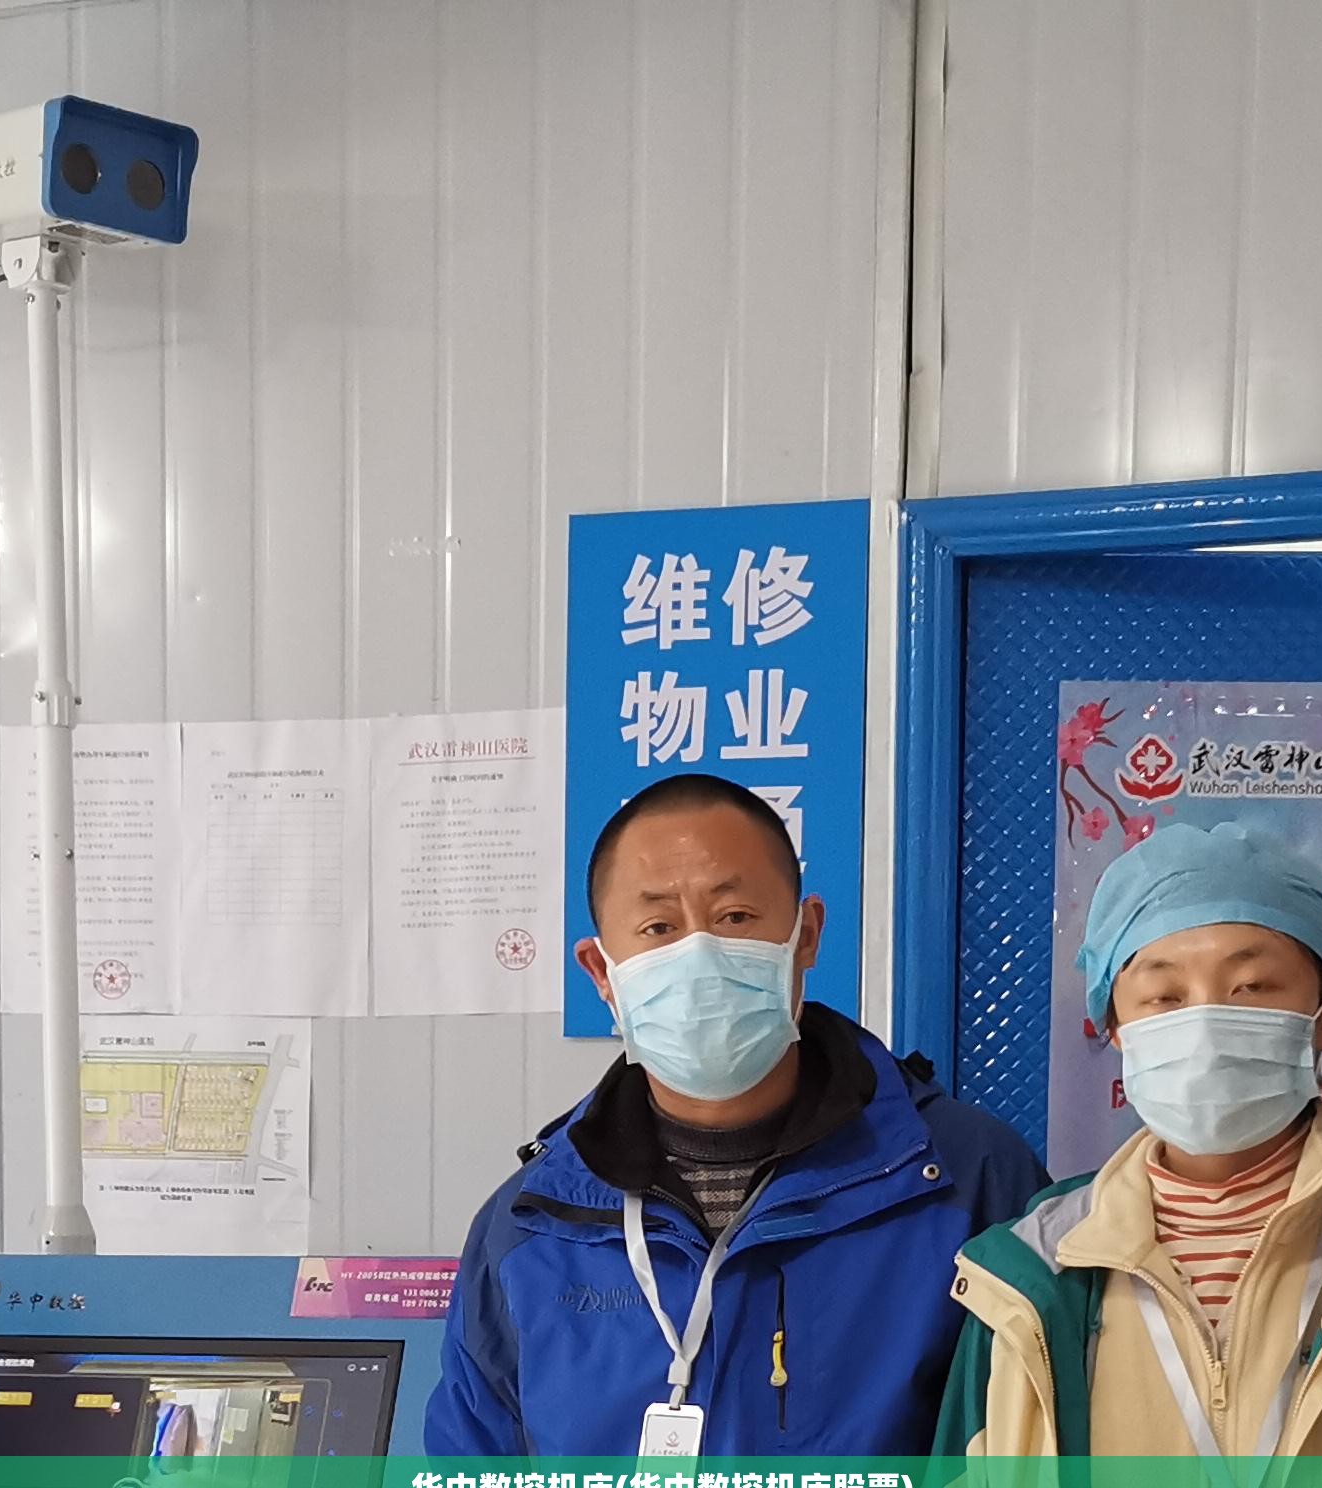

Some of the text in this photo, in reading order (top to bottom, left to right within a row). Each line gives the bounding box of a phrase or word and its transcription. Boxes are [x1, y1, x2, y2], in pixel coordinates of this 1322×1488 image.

[620, 545, 815, 650] 维修
[407, 736, 529, 760] 武汉雷神山医院
[619, 668, 809, 767] 物业
[1189, 781, 1239, 795] Wuhan
